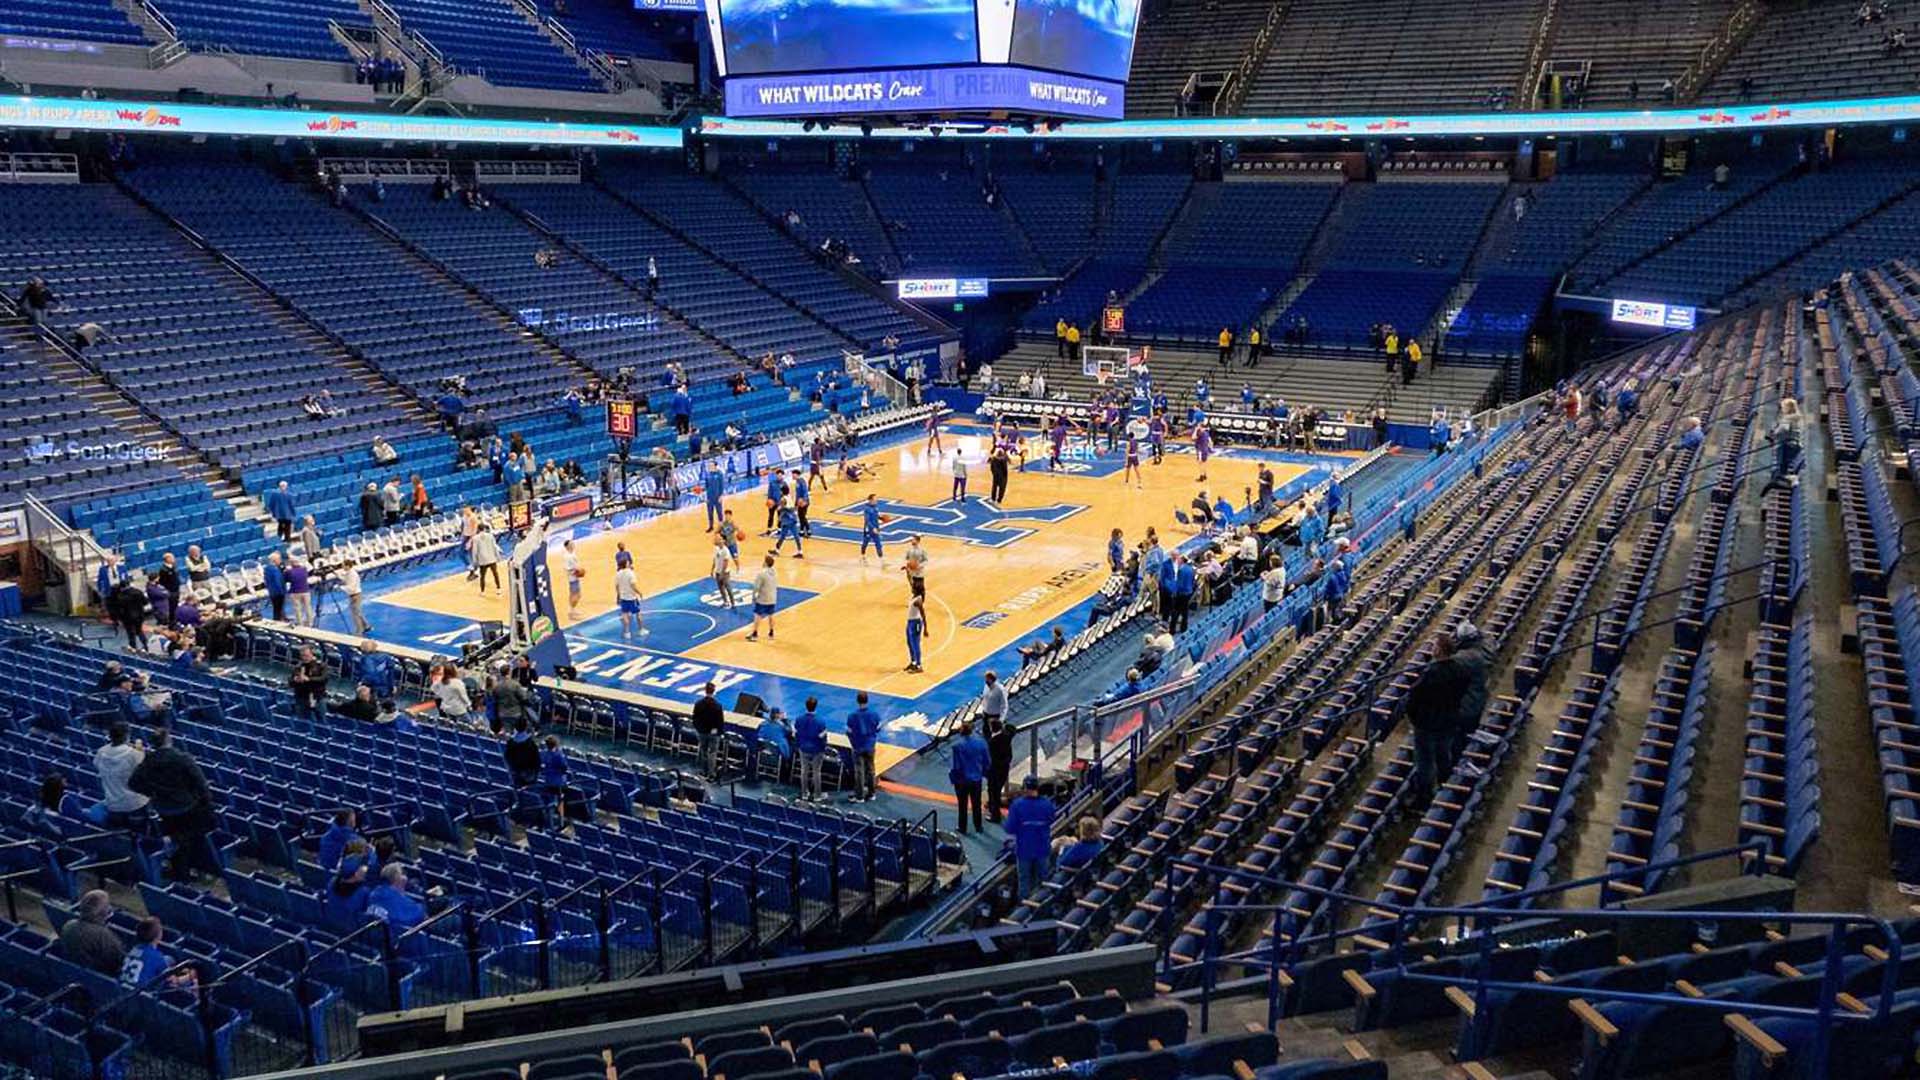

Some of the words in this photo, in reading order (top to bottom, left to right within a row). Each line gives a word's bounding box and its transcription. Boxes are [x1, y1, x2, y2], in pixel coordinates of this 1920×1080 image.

[758, 87, 801, 105] WHAT
[803, 83, 884, 103] WILDCATS
[888, 80, 924, 101] Crave
[1029, 81, 1053, 100] WHAT
[1053, 84, 1092, 106] WILDCATS
[611, 413, 631, 432] 30
[1043, 561, 1101, 589] ARENA
